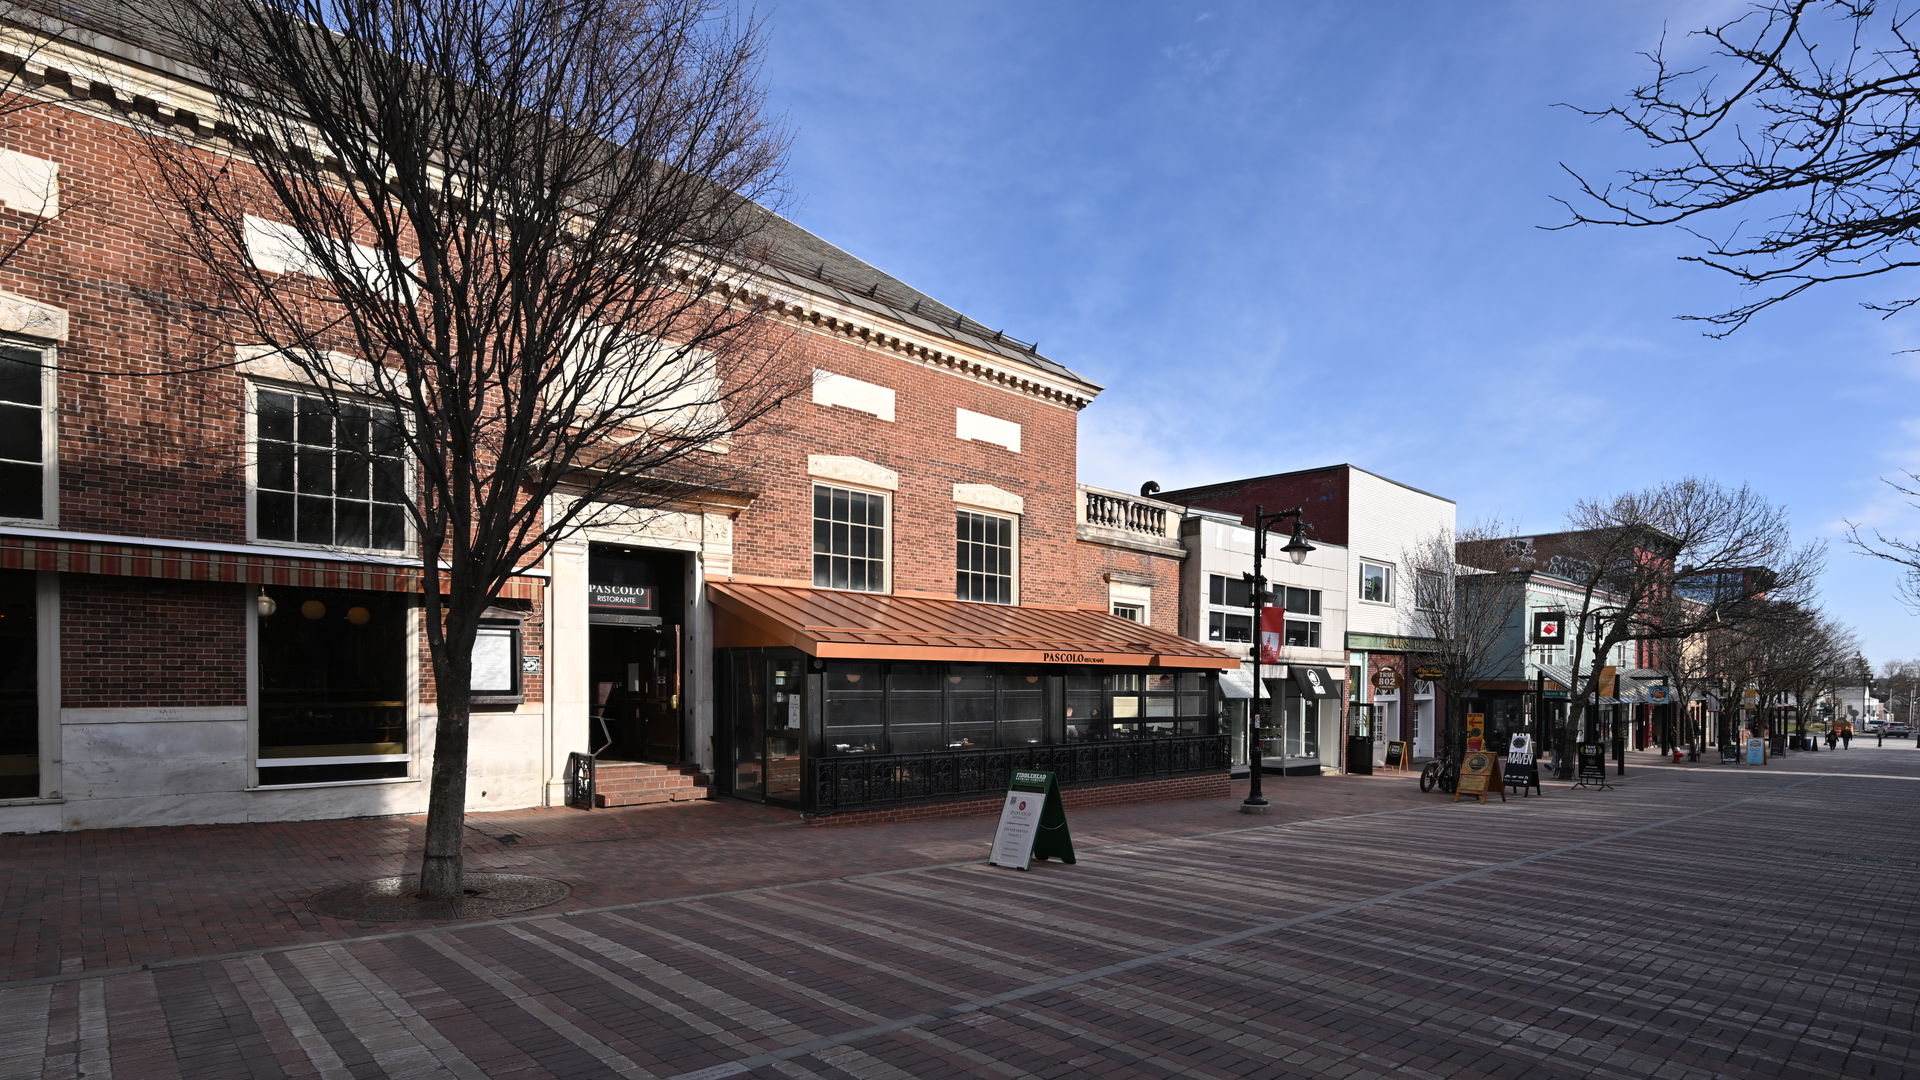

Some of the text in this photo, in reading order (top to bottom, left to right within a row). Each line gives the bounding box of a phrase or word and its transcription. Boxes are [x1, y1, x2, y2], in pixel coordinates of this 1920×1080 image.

[589, 584, 644, 596] PASCOLO
[597, 595, 636, 604] RISTORANTE
[1043, 652, 1084, 663] PASCOLO
[1378, 677, 1395, 686] 802
[1507, 753, 1534, 765] MAVEN
